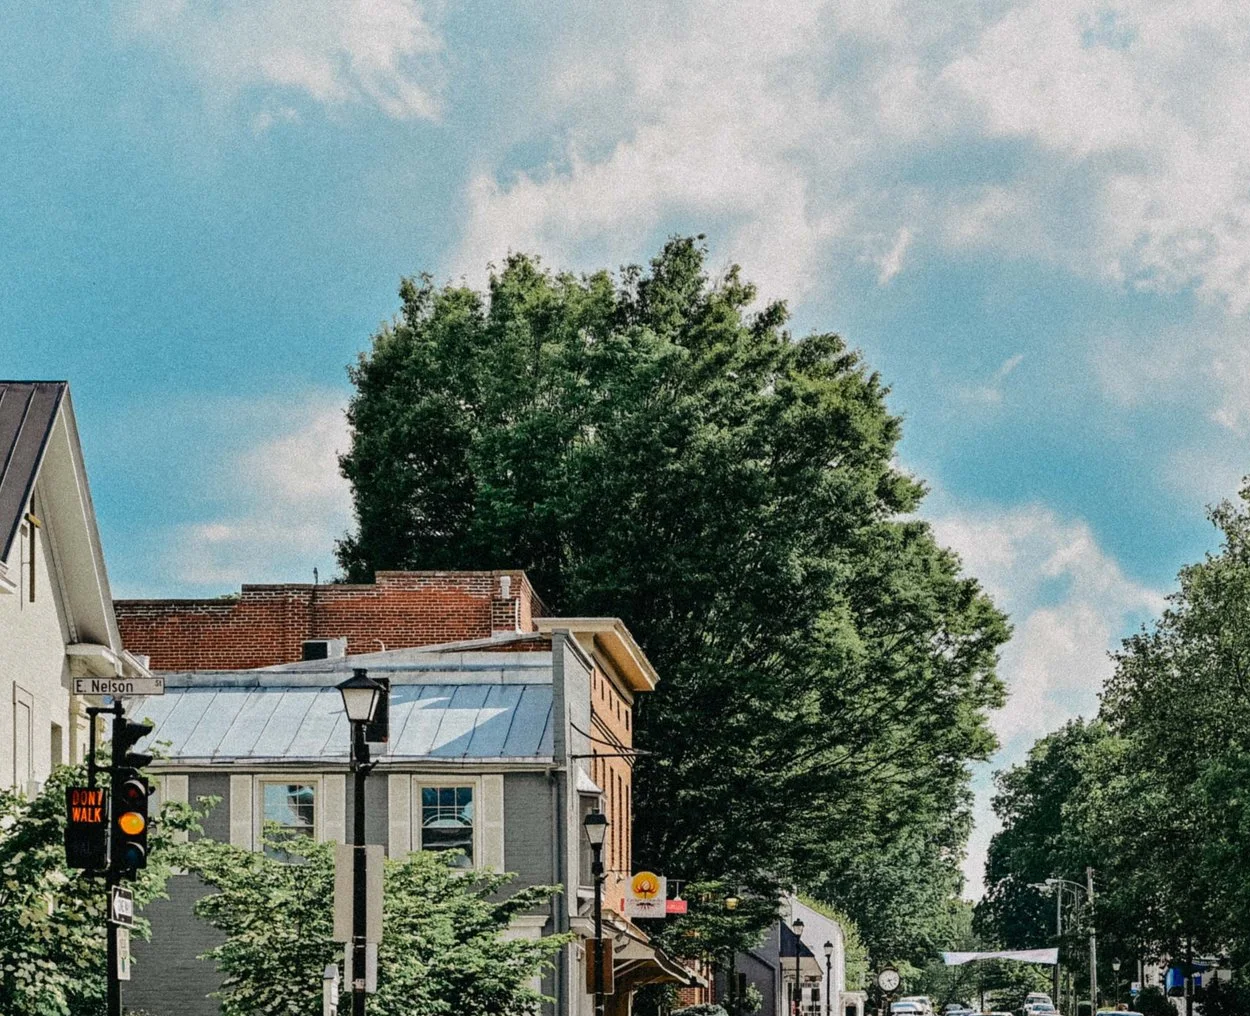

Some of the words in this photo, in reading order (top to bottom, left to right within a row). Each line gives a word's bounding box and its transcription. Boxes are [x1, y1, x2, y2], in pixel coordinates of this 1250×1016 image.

[76, 680, 87, 693] E.
[91, 680, 134, 693] Nelson
[72, 807, 102, 823] WALK
